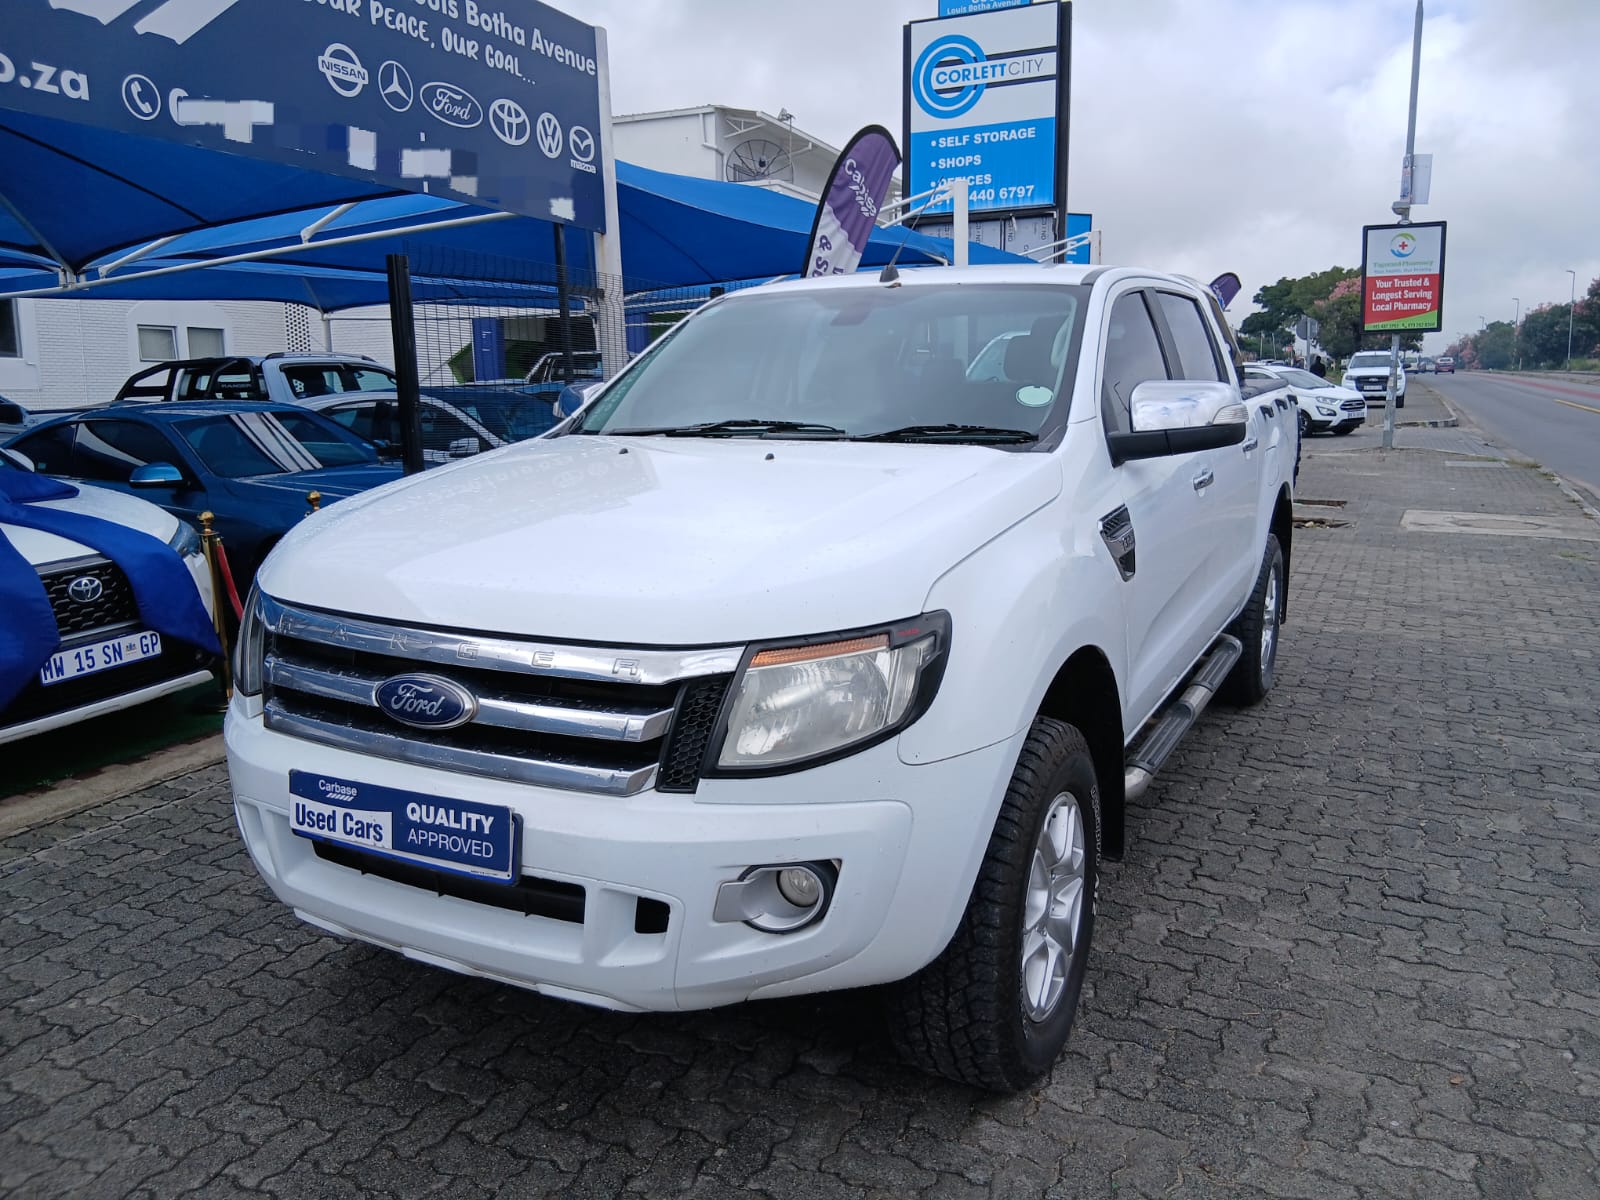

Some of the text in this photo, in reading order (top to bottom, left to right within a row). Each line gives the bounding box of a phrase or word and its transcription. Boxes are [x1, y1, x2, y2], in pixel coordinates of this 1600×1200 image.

[947, 7, 967, 15] Louis
[968, 4, 991, 12] Botha
[370, 0, 435, 49] PEACE,
[441, 27, 479, 61] OUR
[485, 48, 536, 85] GOAL...
[465, 0, 526, 47] Botha
[531, 28, 596, 76] Avenue
[321, 59, 367, 81] NISSAN
[432, 88, 472, 121] Ford
[938, 127, 1036, 148] SELF STORAGE
[938, 155, 982, 169] SHOPS
[938, 173, 992, 188] OCES
[969, 188, 995, 202] 440
[999, 185, 1035, 199] 6797
[1376, 277, 1430, 288] Your Trusted &
[1372, 289, 1433, 301] Longest Serving
[1372, 301, 1432, 312] Local Pharmacy
[74, 649, 96, 673] 15
[103, 642, 123, 665] SN
[140, 633, 159, 655] GP
[278, 613, 640, 677] RANGER
[391, 683, 446, 716] Ford
[318, 779, 358, 797] Carbase
[295, 802, 384, 842] Used Cars
[406, 802, 494, 834] QUALITY
[407, 828, 494, 859] APPROVED
